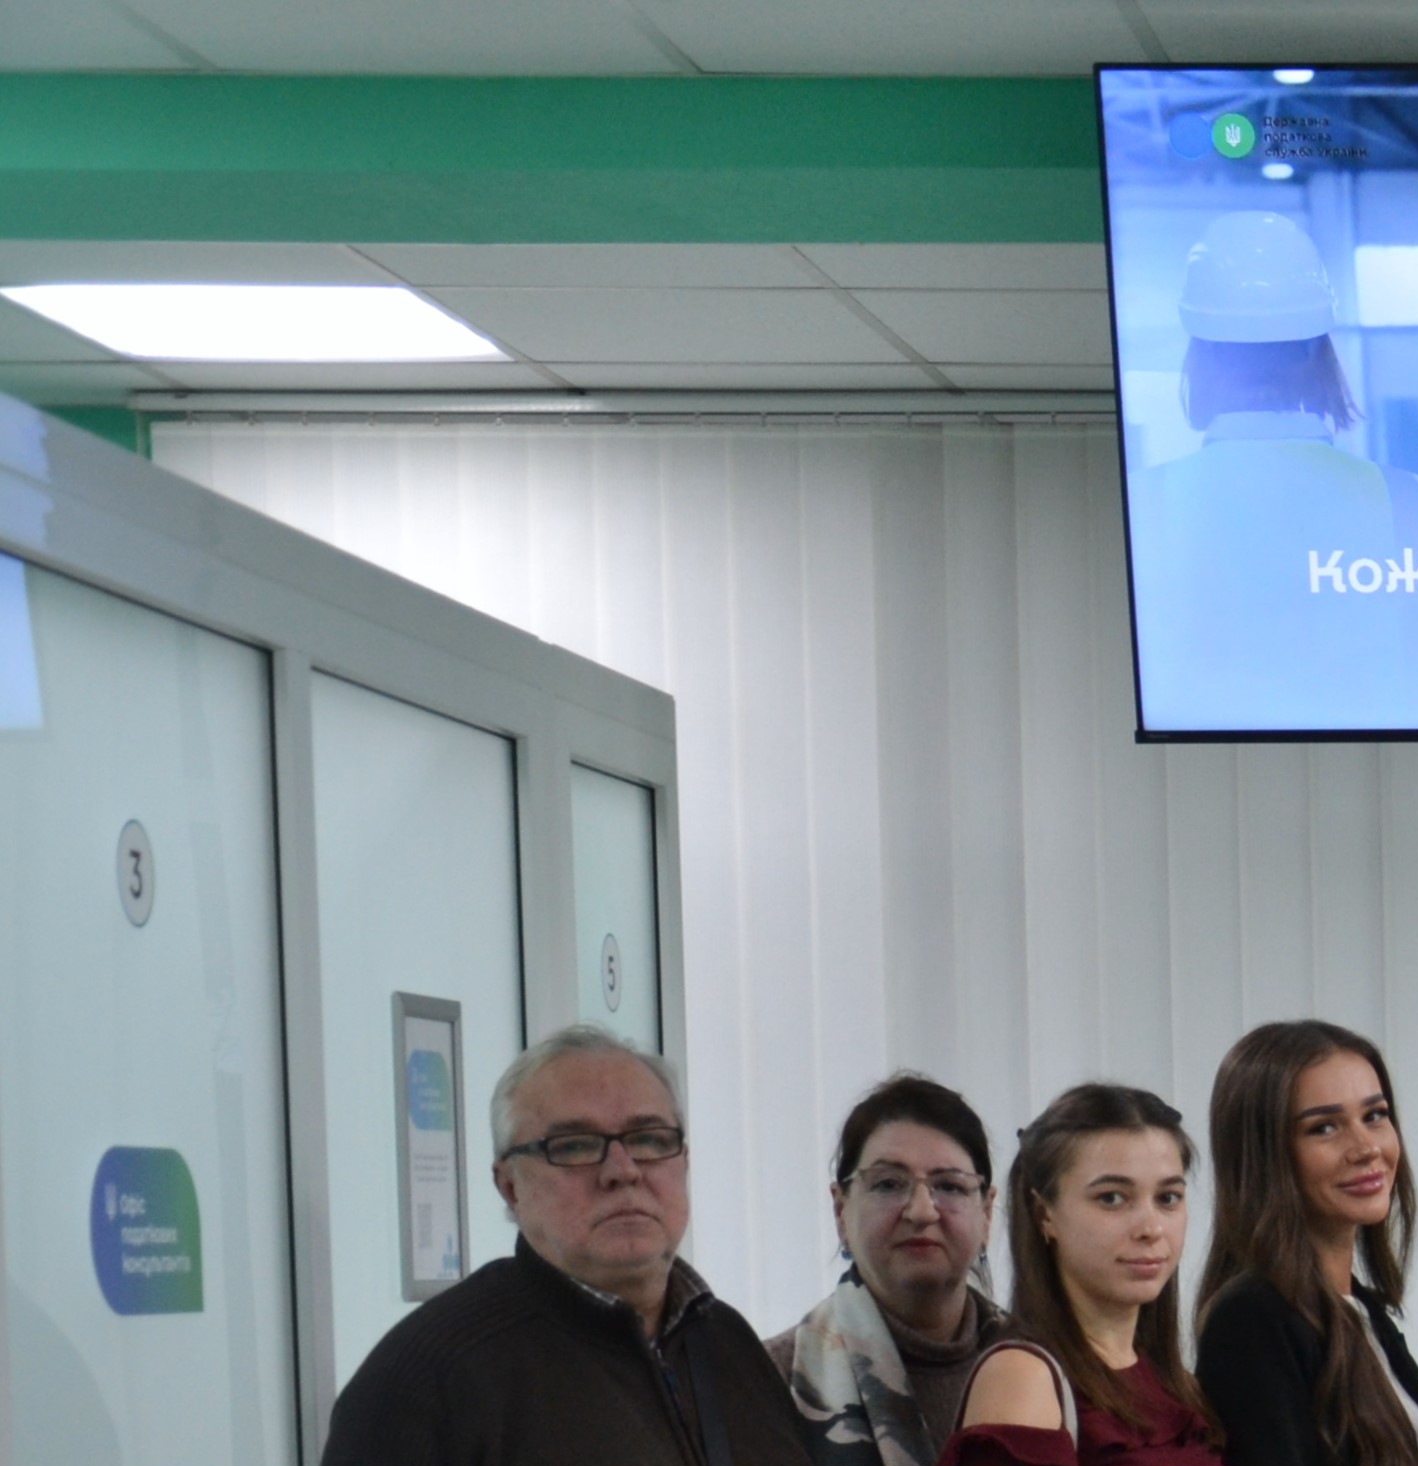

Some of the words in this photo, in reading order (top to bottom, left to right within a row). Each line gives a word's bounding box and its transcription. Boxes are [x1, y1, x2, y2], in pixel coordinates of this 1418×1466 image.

[1263, 116, 1330, 128] Державна
[1263, 132, 1332, 144] податкова
[129, 849, 143, 900] 3
[607, 955, 616, 992] 5
